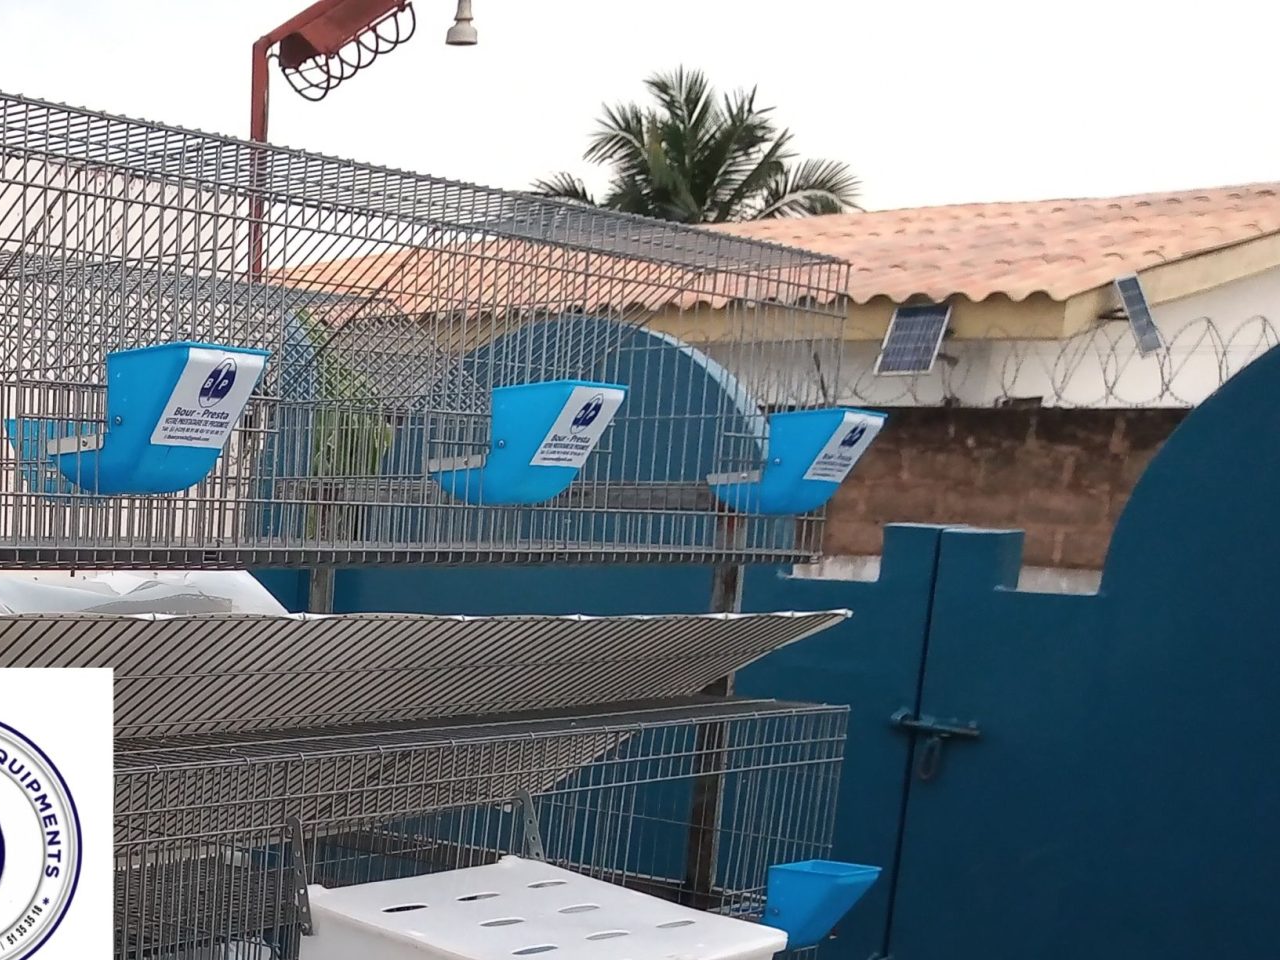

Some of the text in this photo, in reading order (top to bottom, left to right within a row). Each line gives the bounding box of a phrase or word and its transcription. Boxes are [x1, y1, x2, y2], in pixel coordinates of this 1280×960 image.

[204, 378, 229, 390] B P
[174, 406, 196, 417] Bour
[201, 409, 230, 420] Presta
